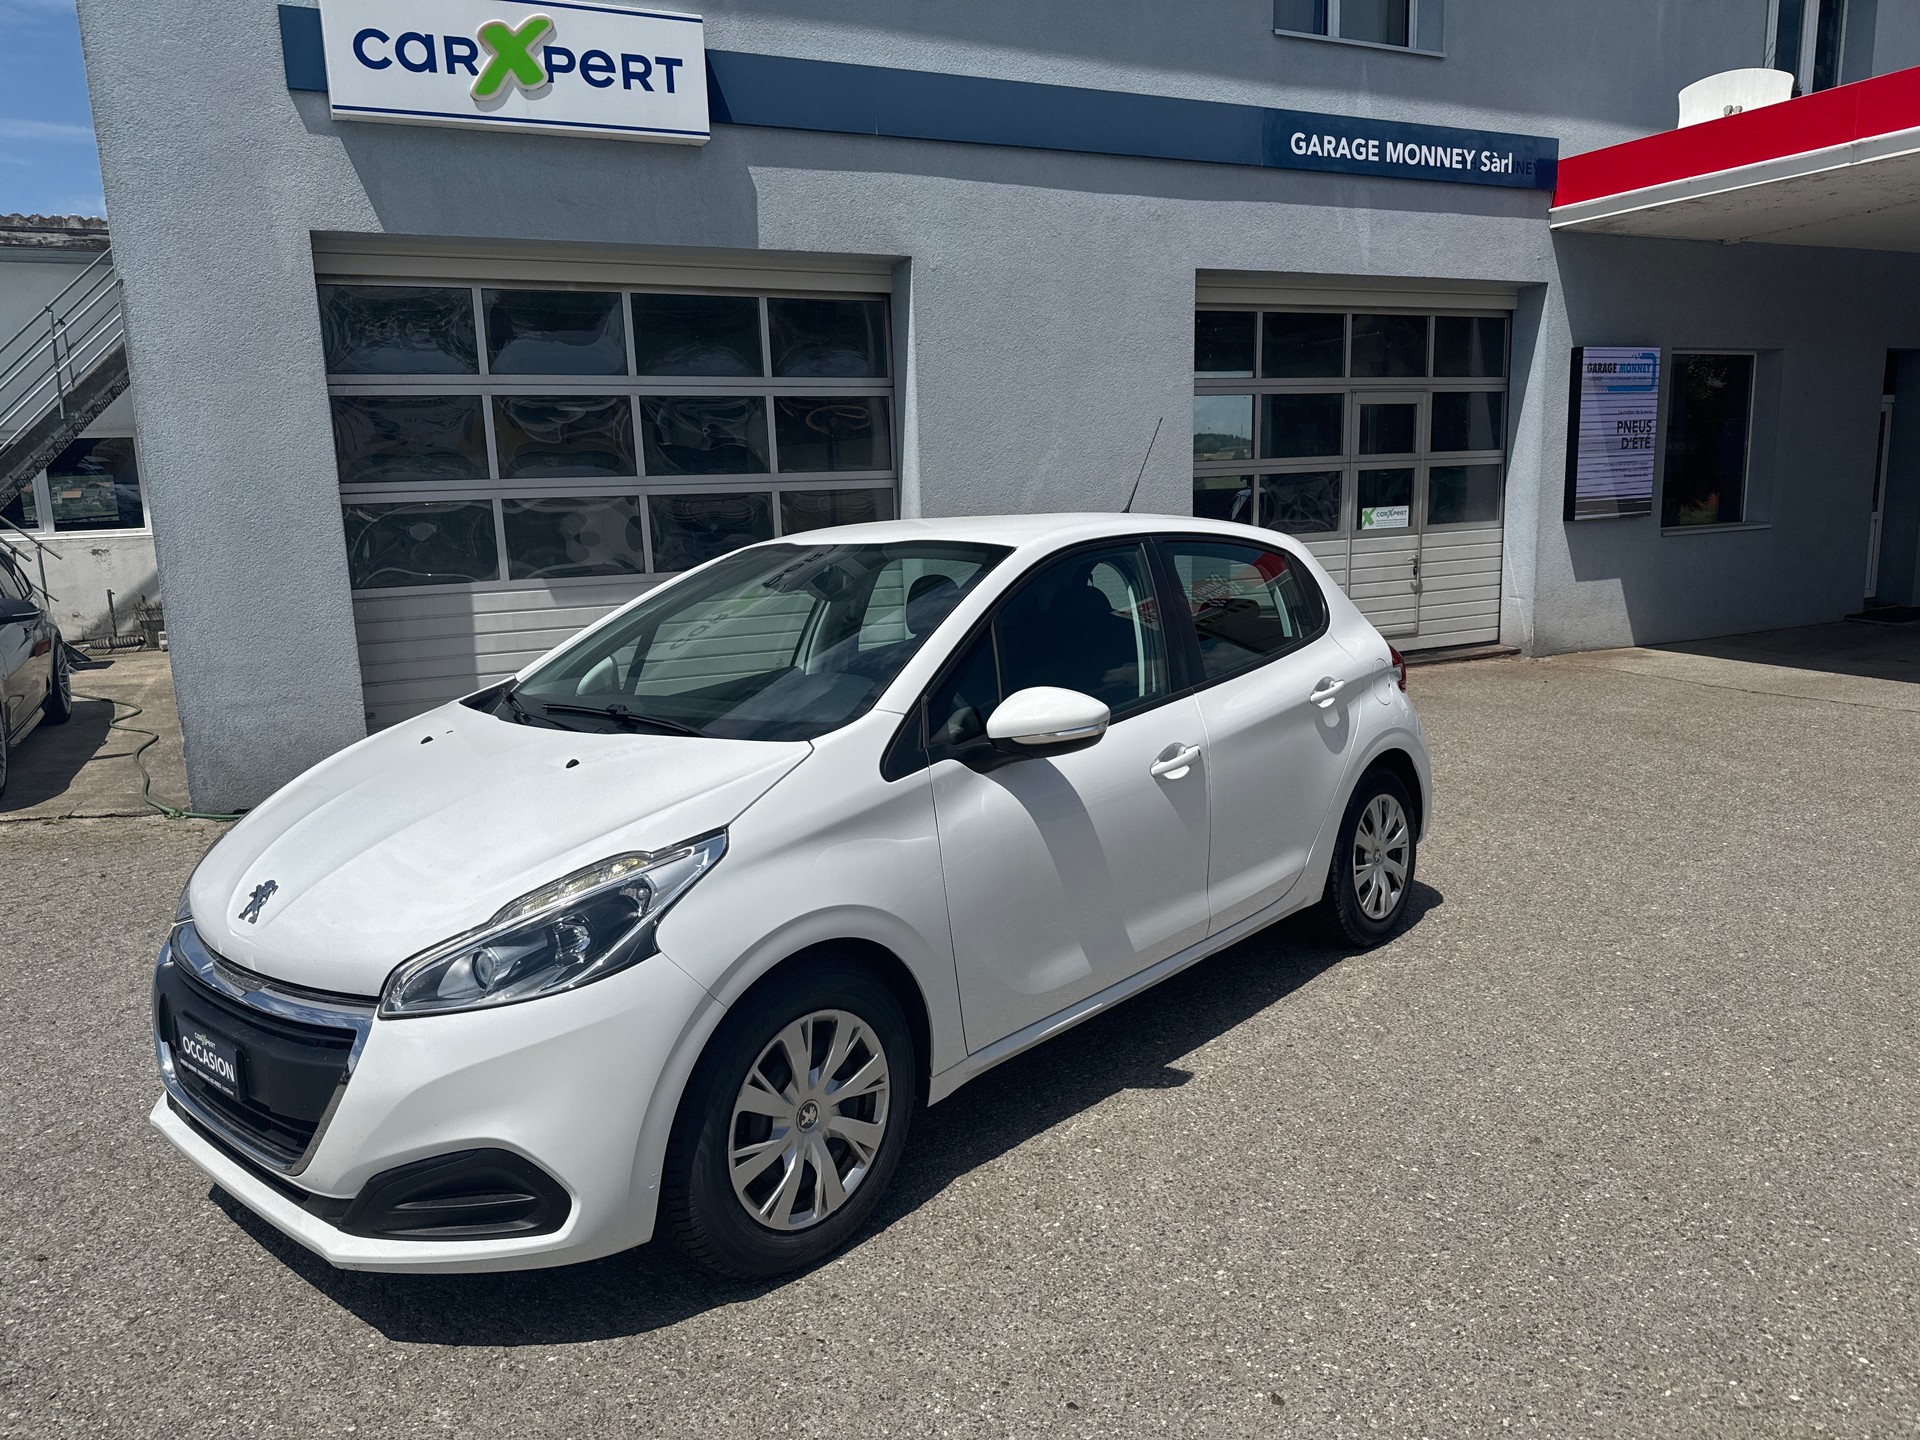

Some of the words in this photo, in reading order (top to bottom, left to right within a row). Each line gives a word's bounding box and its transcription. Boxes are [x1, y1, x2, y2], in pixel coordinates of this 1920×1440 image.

[1290, 132, 1380, 162] GARAGE
[1386, 142, 1477, 169] MONNEY
[1480, 151, 1513, 174] Sàrl
[1587, 362, 1617, 374] GARAGE
[1618, 362, 1651, 374] MONNEY
[1617, 420, 1652, 434] PNEUS
[1621, 434, 1651, 450] D'ÉTÉ
[182, 1036, 235, 1082] OCCASION
